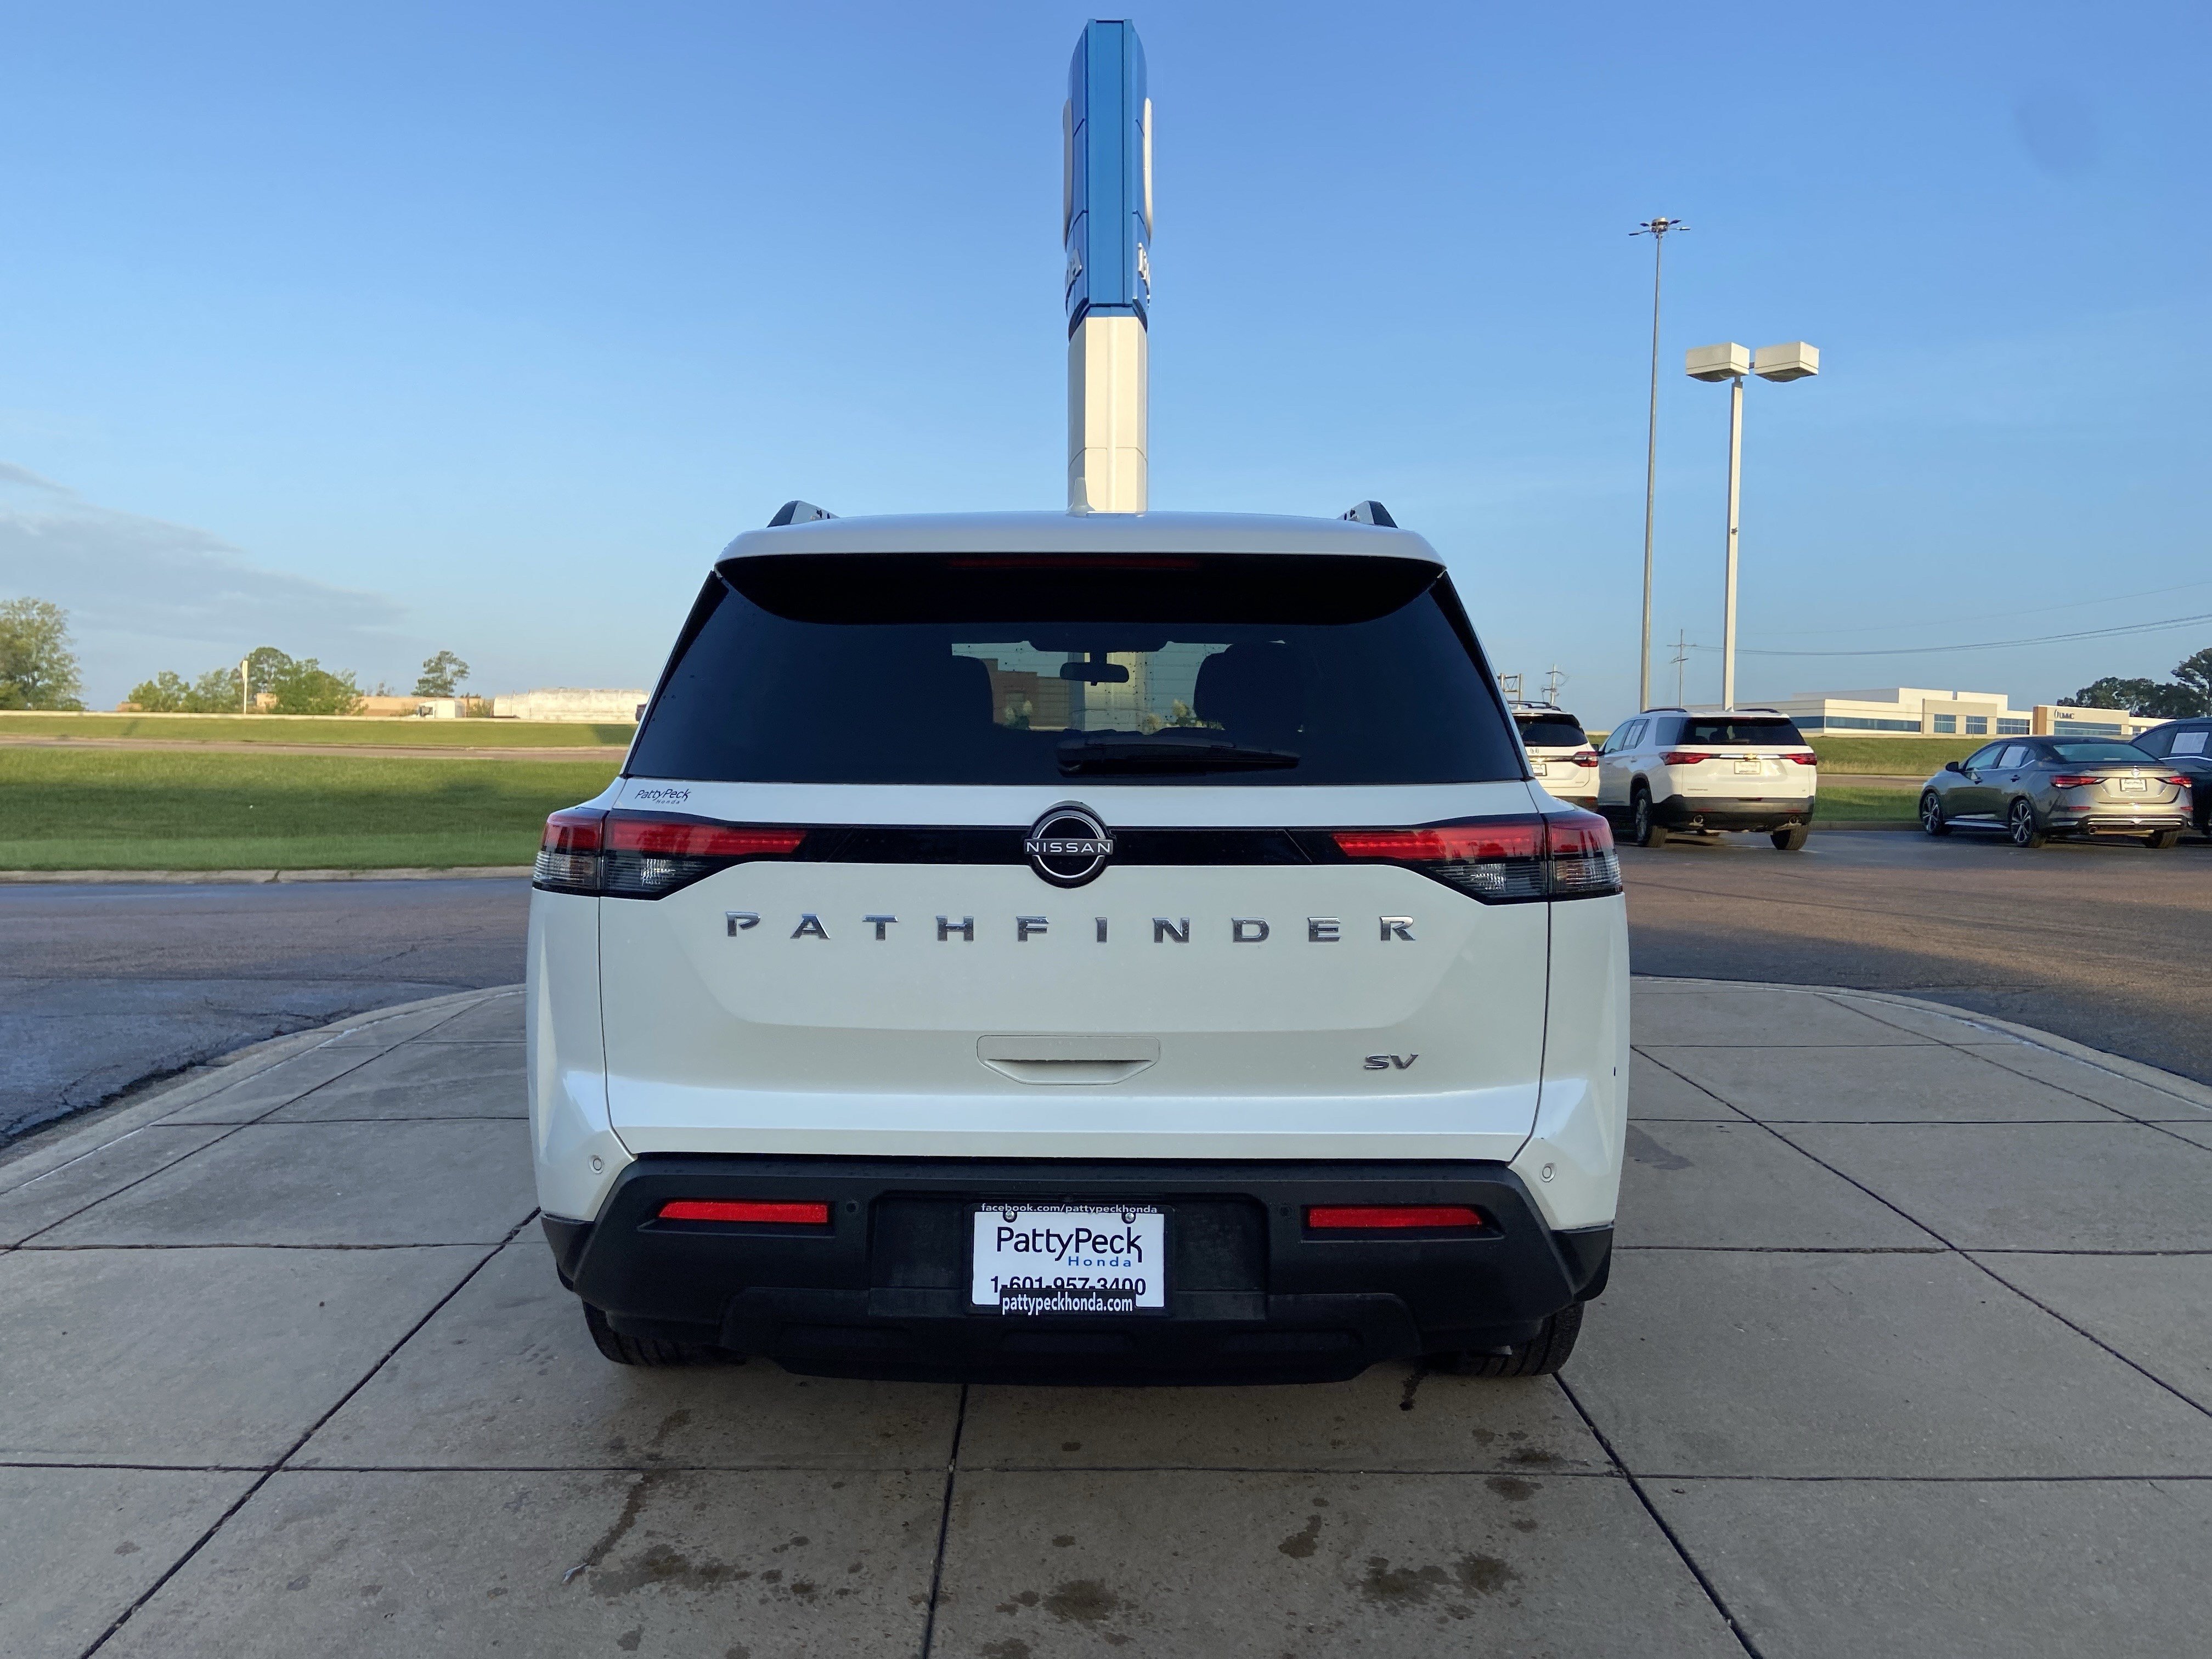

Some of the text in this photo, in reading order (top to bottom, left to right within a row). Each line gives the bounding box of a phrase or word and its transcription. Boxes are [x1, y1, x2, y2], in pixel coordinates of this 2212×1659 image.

[635, 789, 691, 802] PattyPeck
[1026, 842, 1110, 853] NISSAN
[726, 911, 1417, 943] PATHFINDER
[1363, 1053, 1419, 1069] SV
[981, 1203, 1157, 1214] facebook.com/pattypeckhonda
[997, 1226, 1142, 1262] PattyPeck
[1068, 1256, 1131, 1267] Honda
[991, 1276, 1146, 1295] 1-601-957-3400
[1002, 1292, 1133, 1316] pattypeckhonda.com
